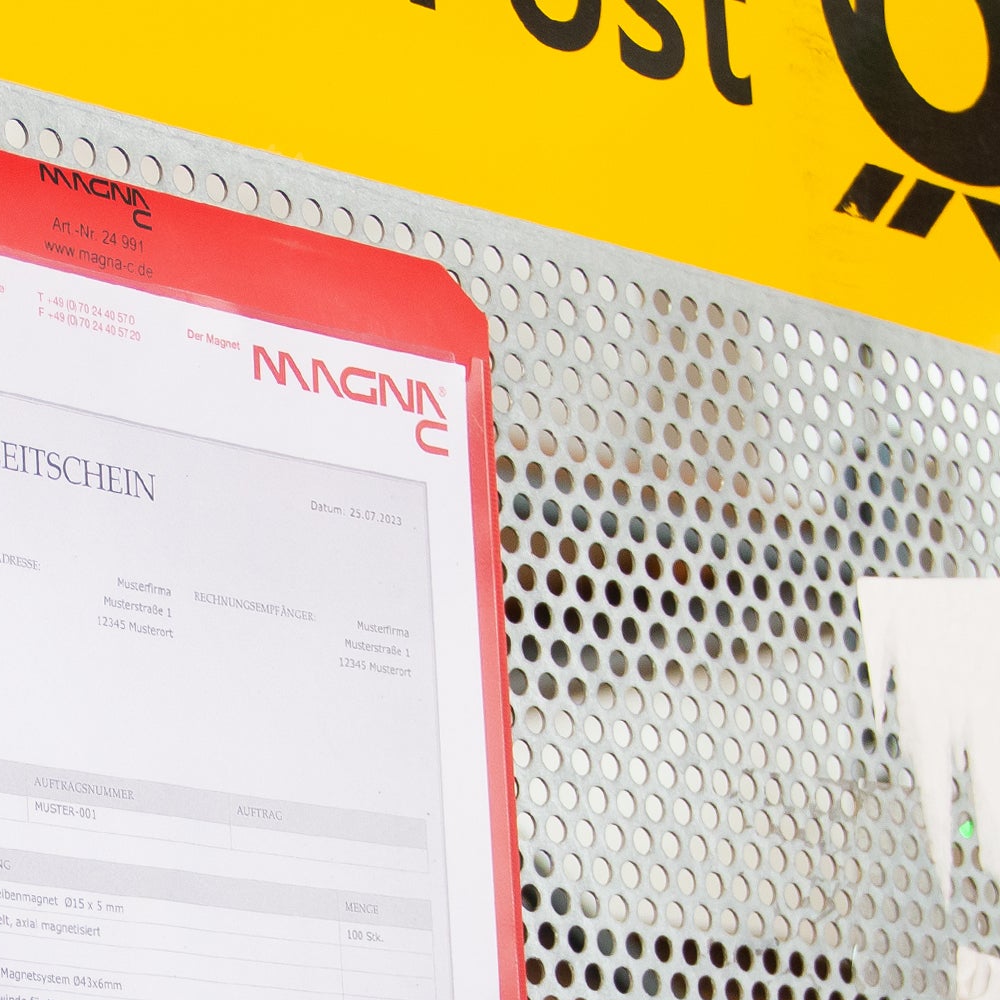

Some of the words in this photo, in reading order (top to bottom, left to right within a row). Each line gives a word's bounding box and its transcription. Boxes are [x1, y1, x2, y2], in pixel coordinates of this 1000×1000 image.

[409, 0, 753, 106] st
[39, 163, 150, 210] MAGNA
[102, 231, 117, 246] 24
[122, 234, 143, 252] 991
[187, 329, 204, 341] Der
[206, 333, 240, 350] Magnet
[311, 500, 345, 516] Datum:
[350, 508, 402, 526] 25.07.2023
[117, 577, 171, 597] Musterfirma
[103, 596, 163, 616] Musterstraße
[167, 608, 171, 618] 1
[98, 616, 125, 630] 12345
[129, 621, 173, 639] Musterort
[357, 620, 409, 638] Musterfirma
[345, 638, 402, 656] Musterstraße
[406, 649, 410, 657] 1
[339, 658, 366, 670] 12345
[369, 662, 411, 677] Musterort
[34, 777, 135, 800] AUFTRAGSNUMMER
[35, 801, 97, 820] MUSTER-001
[237, 805, 283, 821] AUFTRAG
[106, 902, 124, 913] mm
[345, 901, 378, 915] MENGE
[41, 920, 101, 937] magnetisiert
[347, 929, 363, 941] 100
[366, 931, 384, 942] Stk.
[0, 967, 70, 985] Magnetsystem
